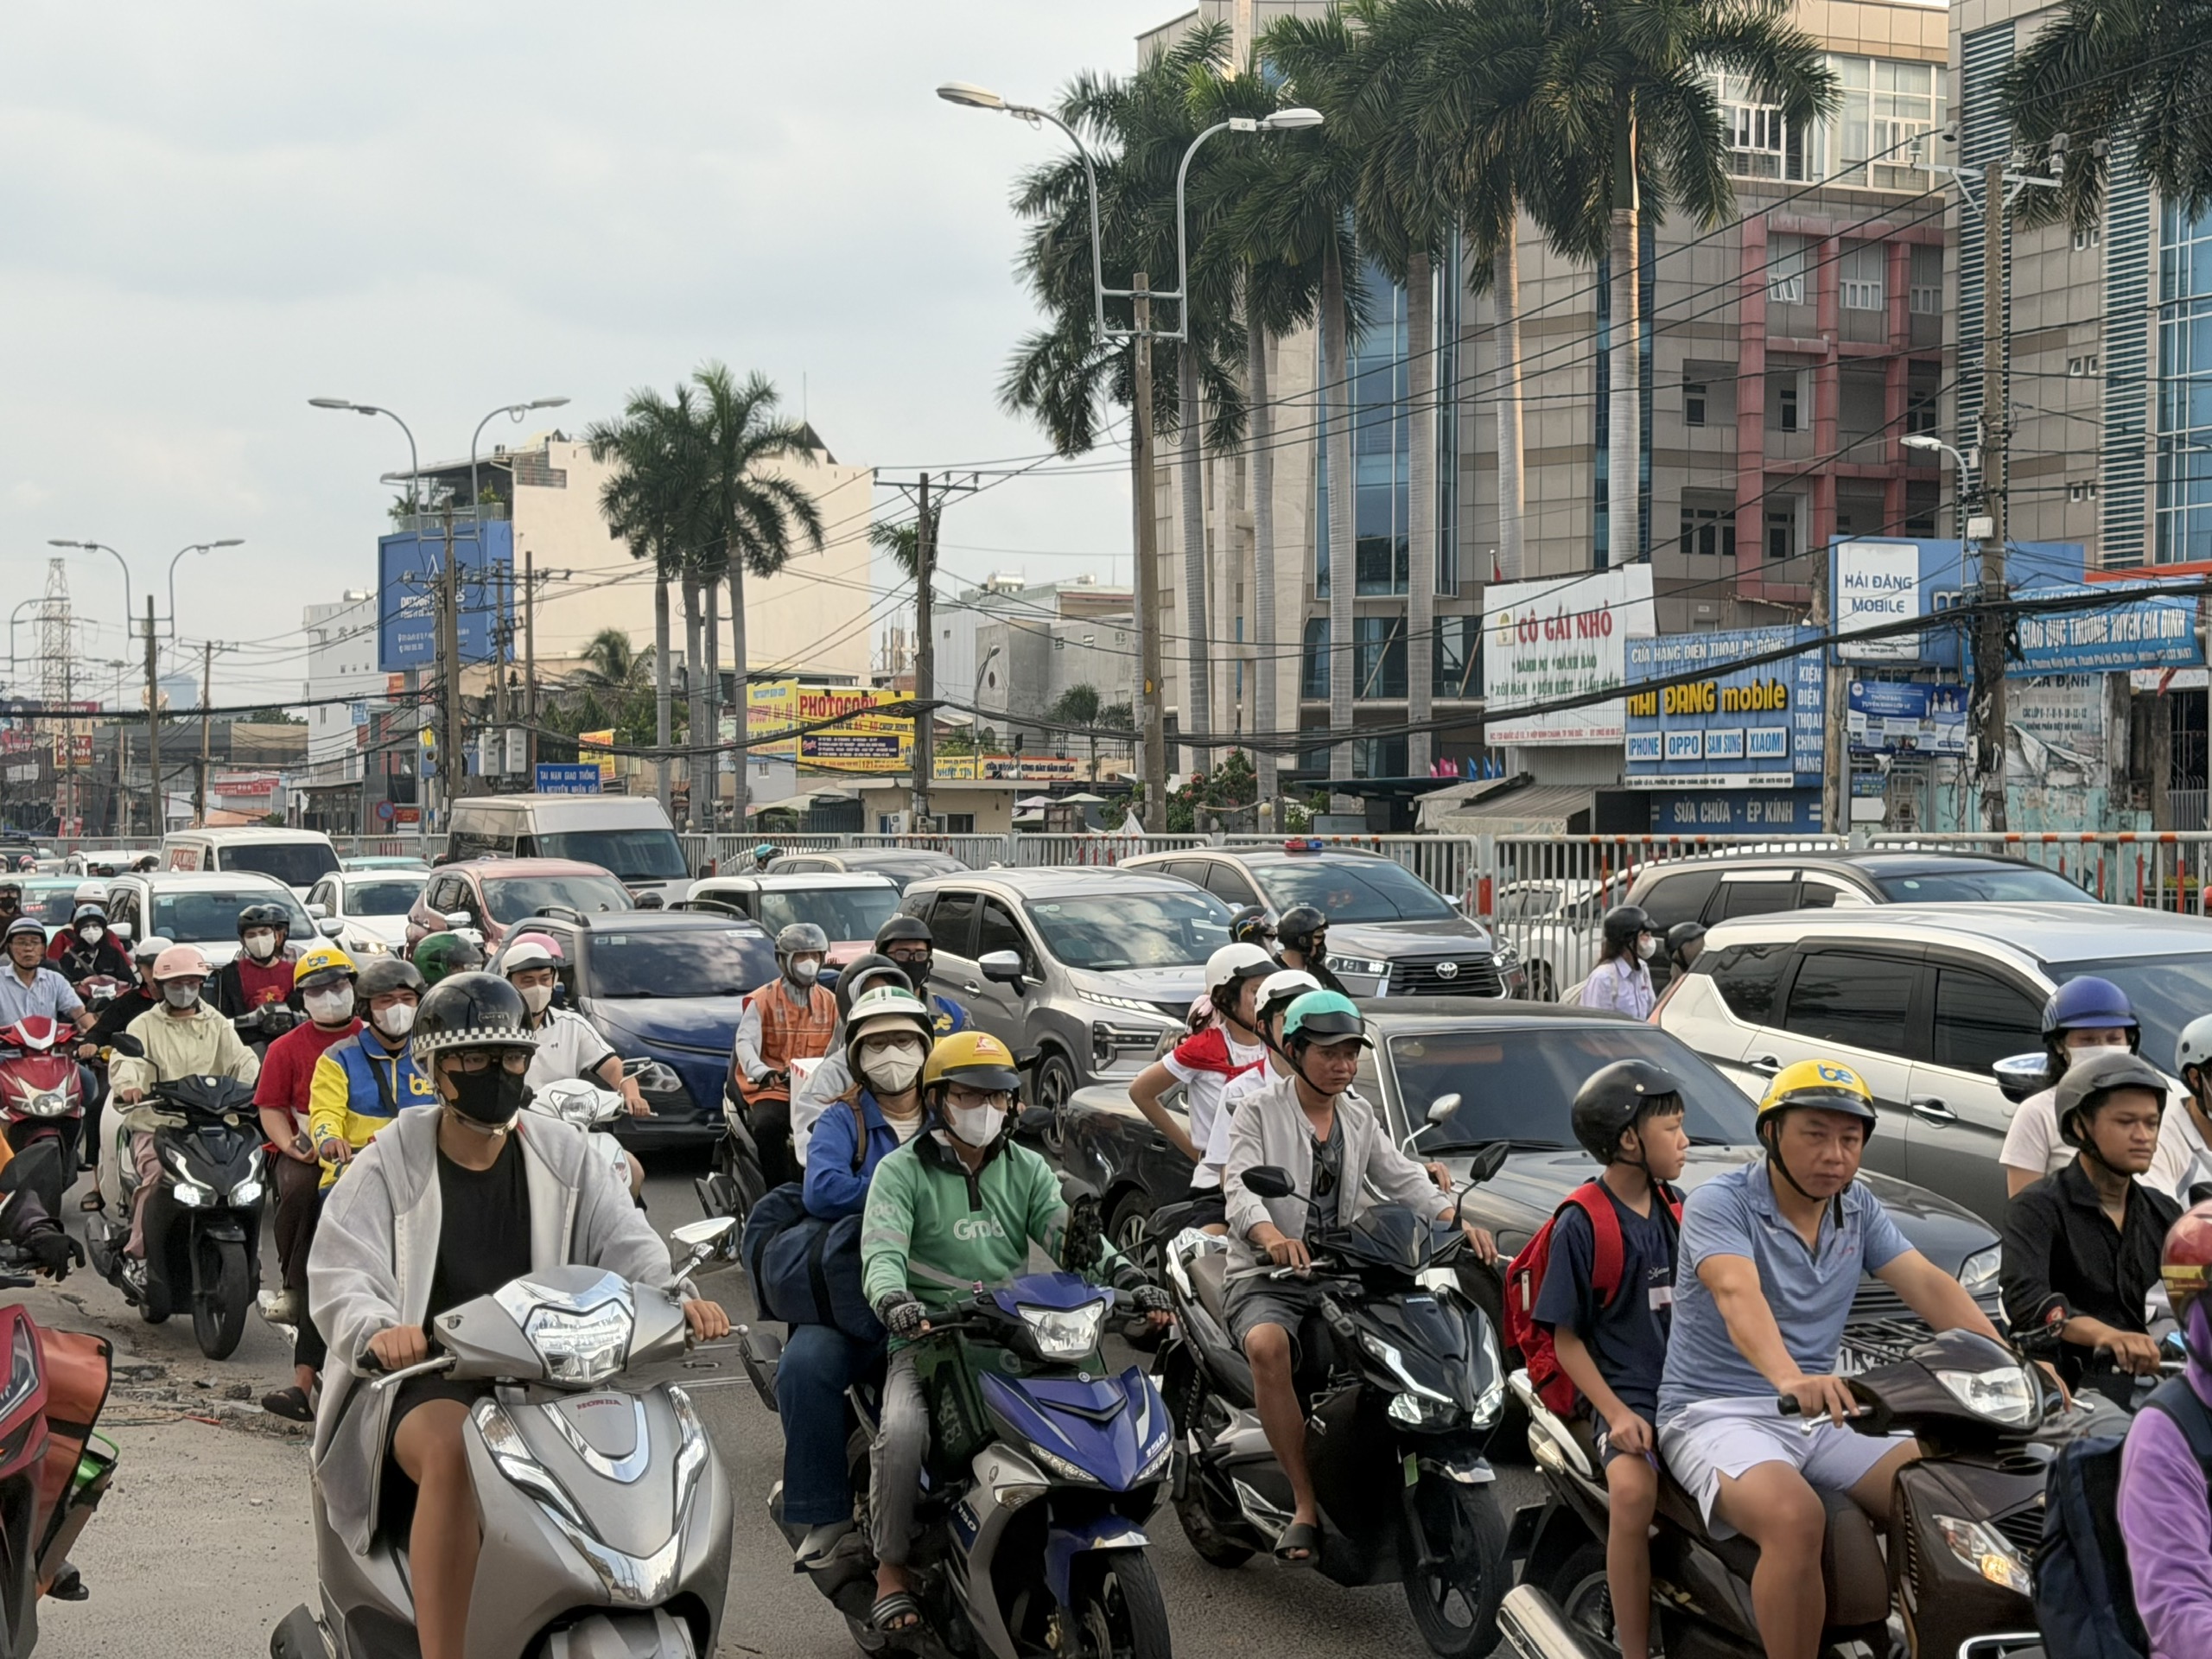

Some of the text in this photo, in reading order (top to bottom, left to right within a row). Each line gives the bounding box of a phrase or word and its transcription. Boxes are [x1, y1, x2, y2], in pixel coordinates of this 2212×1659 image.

[1845, 571, 1912, 589] HẢI ĐĂNG
[1852, 598, 1904, 613] MOBILE
[1518, 599, 1612, 644] CÔ GÁI NHỎ
[2046, 619, 2066, 653] DỤC
[2069, 609, 2108, 645] THƯỜNG
[2143, 611, 2158, 639] GIA
[2161, 609, 2186, 645] ĐỊNH
[1631, 645, 1650, 663] CỬA
[1654, 643, 1681, 662] HÀNG
[1710, 641, 1739, 659] THOẠI
[1799, 664, 1821, 684] KIỆN
[2056, 675, 2090, 690] ĐỊNH
[1722, 678, 1786, 711] mobile
[1797, 687, 1820, 709] ĐIỆN
[1795, 713, 1822, 732] THOẠI
[1629, 736, 1659, 756] IPHONE
[1669, 735, 1699, 754] OPPO
[1707, 734, 1741, 753] SAM SUNG
[1750, 733, 1783, 753] XIAOMI
[1795, 731, 1823, 751] CHÍNH
[1796, 753, 1821, 772] HÀNG
[564, 771, 576, 780] GIAO
[579, 768, 595, 780] THÔNG
[1675, 797, 1731, 823] SỬA CHỮA
[1746, 798, 1793, 823] ÉP KÍNH
[1817, 1064, 1854, 1084] be
[576, 1399, 622, 1410] HONDA
[1146, 1432, 1166, 1458] 150
